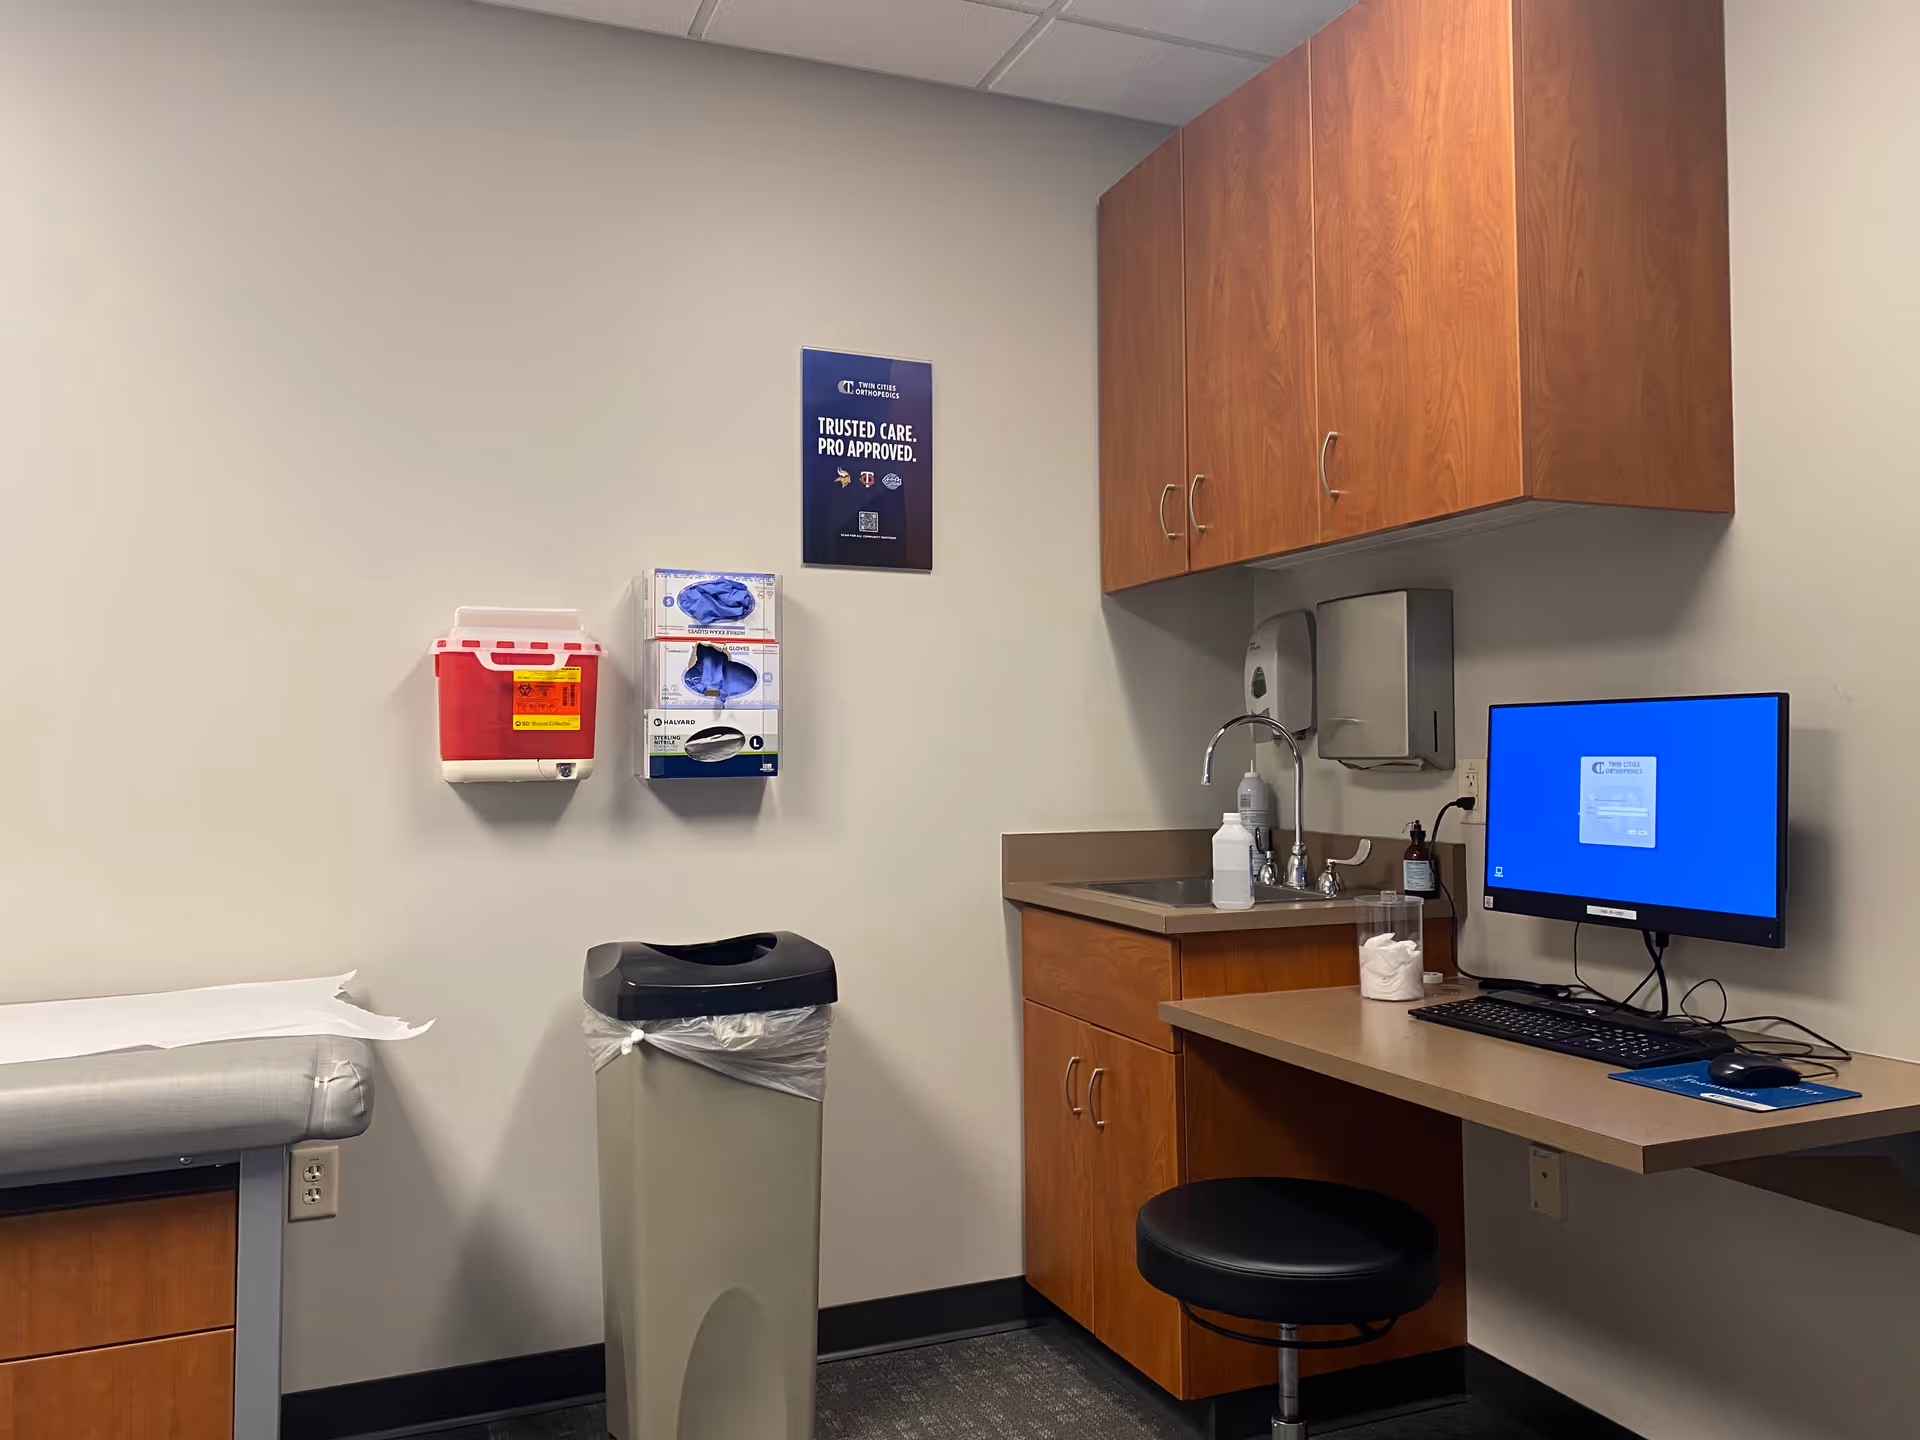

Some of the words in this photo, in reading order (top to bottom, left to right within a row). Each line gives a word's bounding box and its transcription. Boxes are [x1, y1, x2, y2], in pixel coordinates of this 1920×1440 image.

[858, 381, 876, 390] TWIN
[876, 383, 897, 392] CITIES
[855, 388, 900, 399] ORTHOPEDICS
[817, 416, 876, 439] TRUSTED
[879, 422, 917, 443] CARE.
[817, 437, 845, 457] PRO
[846, 439, 917, 463] APPROVED.
[753, 738, 760, 747] L
